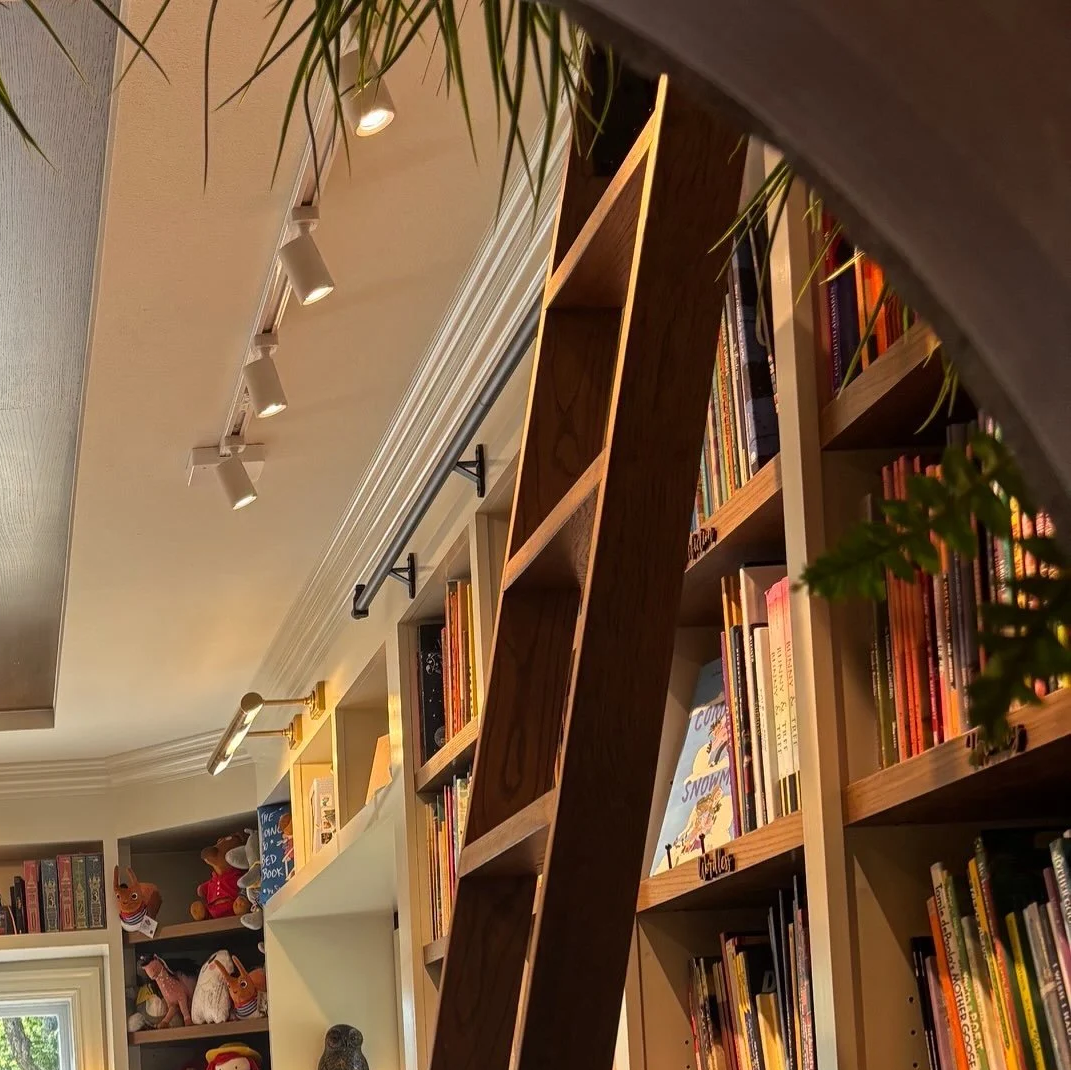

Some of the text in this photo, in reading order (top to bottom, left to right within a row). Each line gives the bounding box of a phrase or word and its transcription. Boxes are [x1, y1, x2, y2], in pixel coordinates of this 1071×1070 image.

[682, 769, 730, 803] SNOWM
[262, 854, 277, 867] BED
[262, 866, 285, 880] BOOK
[935, 883, 946, 917] Tomie
[952, 973, 967, 1021] MOTHER
[962, 1023, 977, 1068] GOOSE
